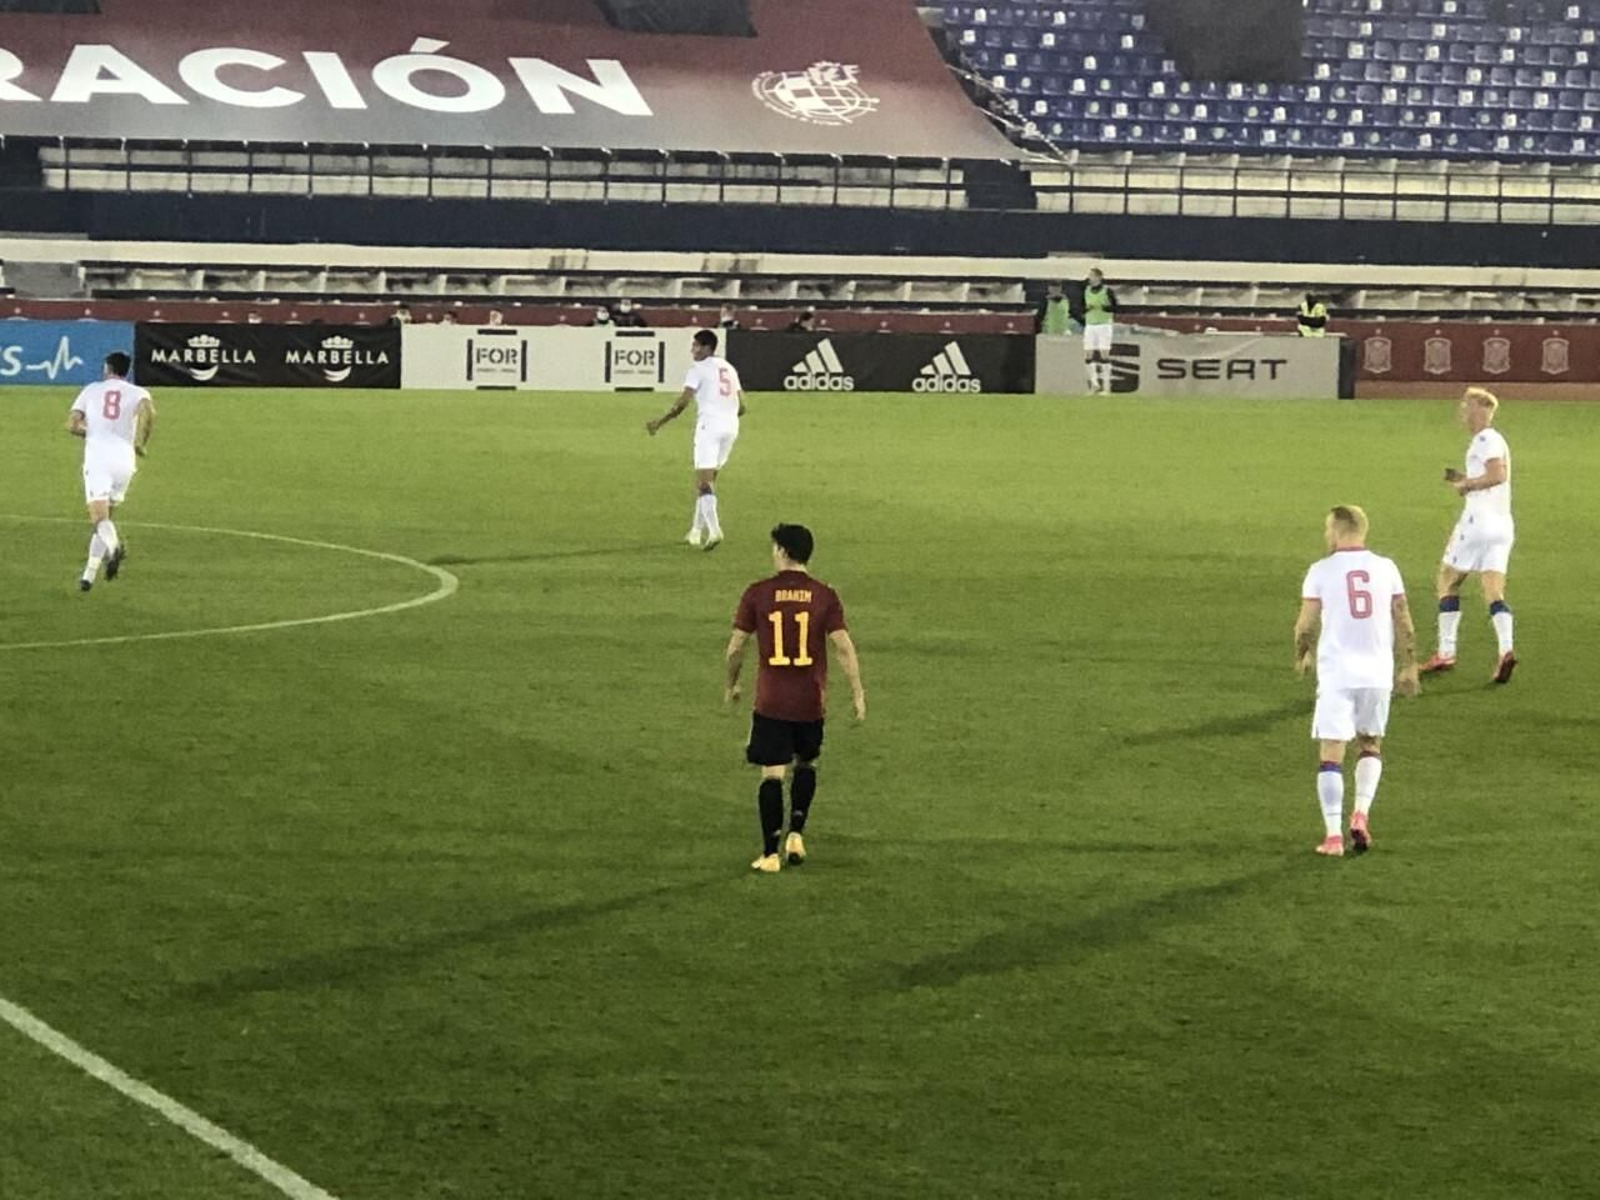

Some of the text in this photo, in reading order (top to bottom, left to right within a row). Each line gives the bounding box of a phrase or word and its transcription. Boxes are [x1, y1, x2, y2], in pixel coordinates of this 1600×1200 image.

[151, 349, 257, 364] MARBELLA
[285, 350, 390, 365] MARBELLA
[476, 347, 518, 365] FOR
[614, 349, 656, 366] FOR
[1156, 358, 1288, 380] SEAT
[718, 367, 732, 398] 5
[783, 372, 855, 391] adidas
[911, 374, 982, 393] adidas
[102, 389, 122, 420] 8
[1346, 569, 1373, 619] 6
[768, 610, 813, 666] 11
